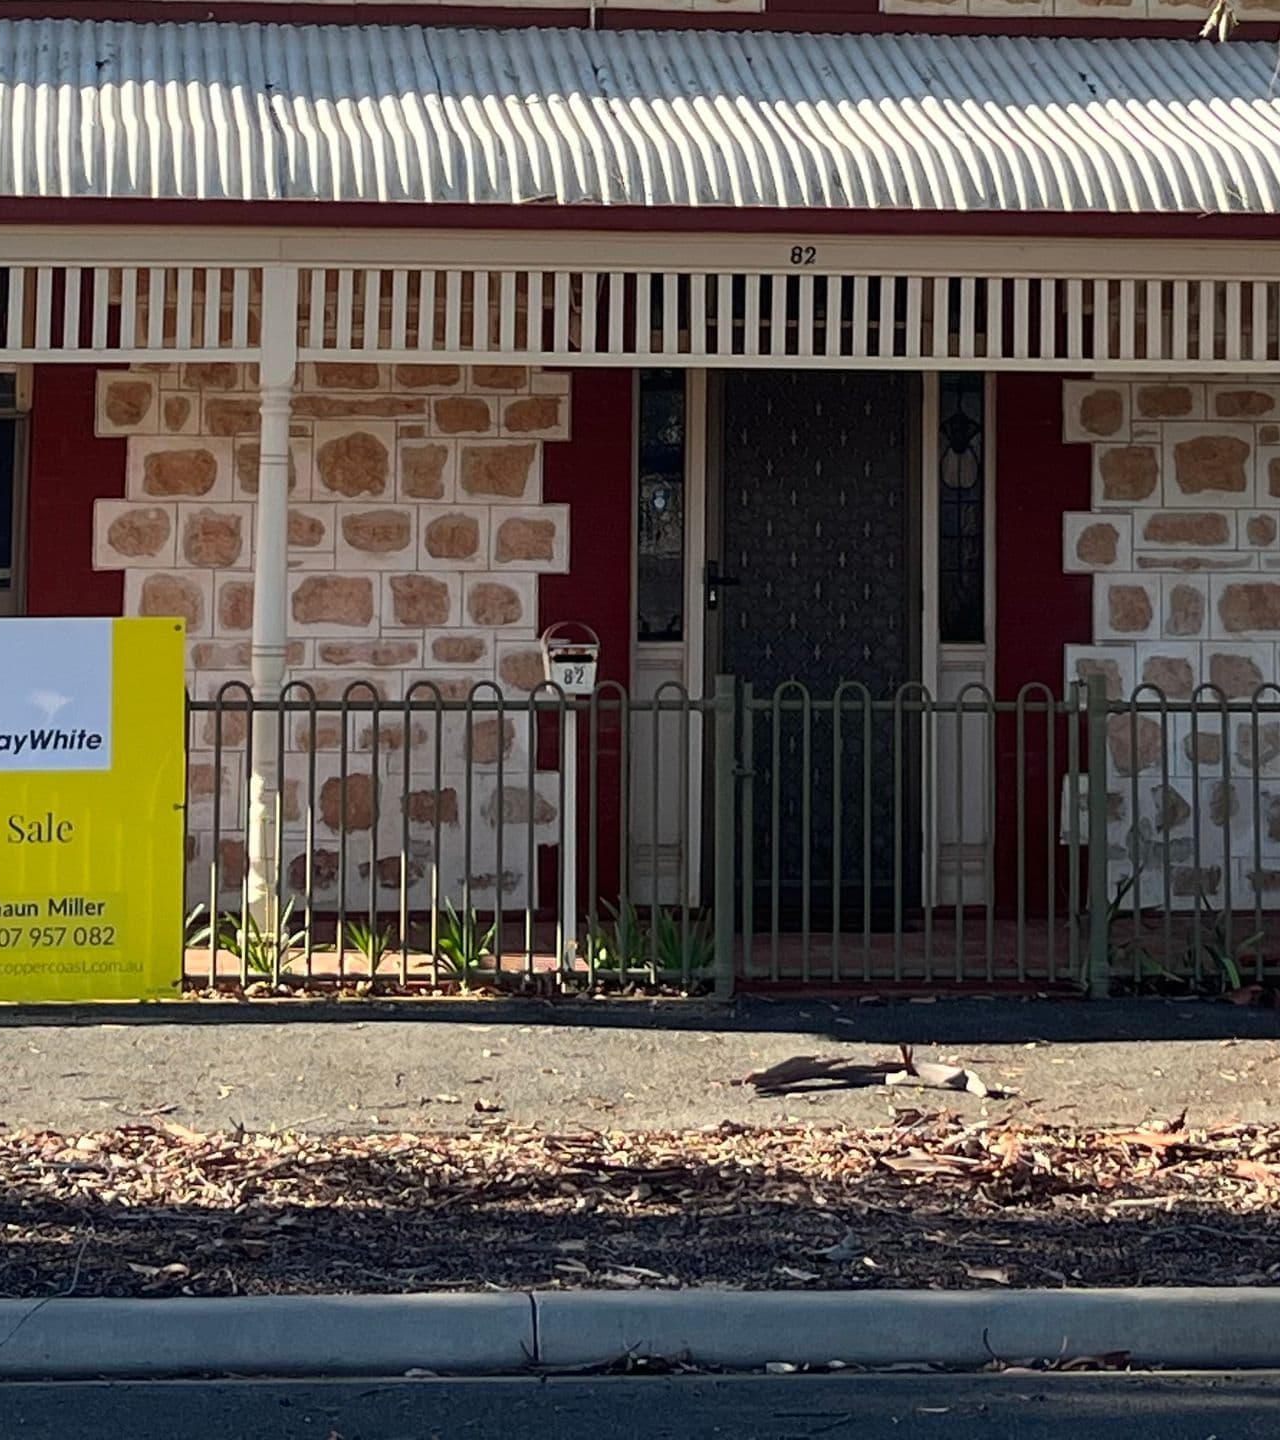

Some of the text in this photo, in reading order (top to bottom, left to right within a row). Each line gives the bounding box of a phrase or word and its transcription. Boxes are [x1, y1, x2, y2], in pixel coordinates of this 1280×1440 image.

[790, 246, 817, 265] 82
[7, 812, 74, 844] Sale
[47, 897, 106, 917] Miller
[29, 926, 67, 947] 957
[73, 926, 115, 946] 082
